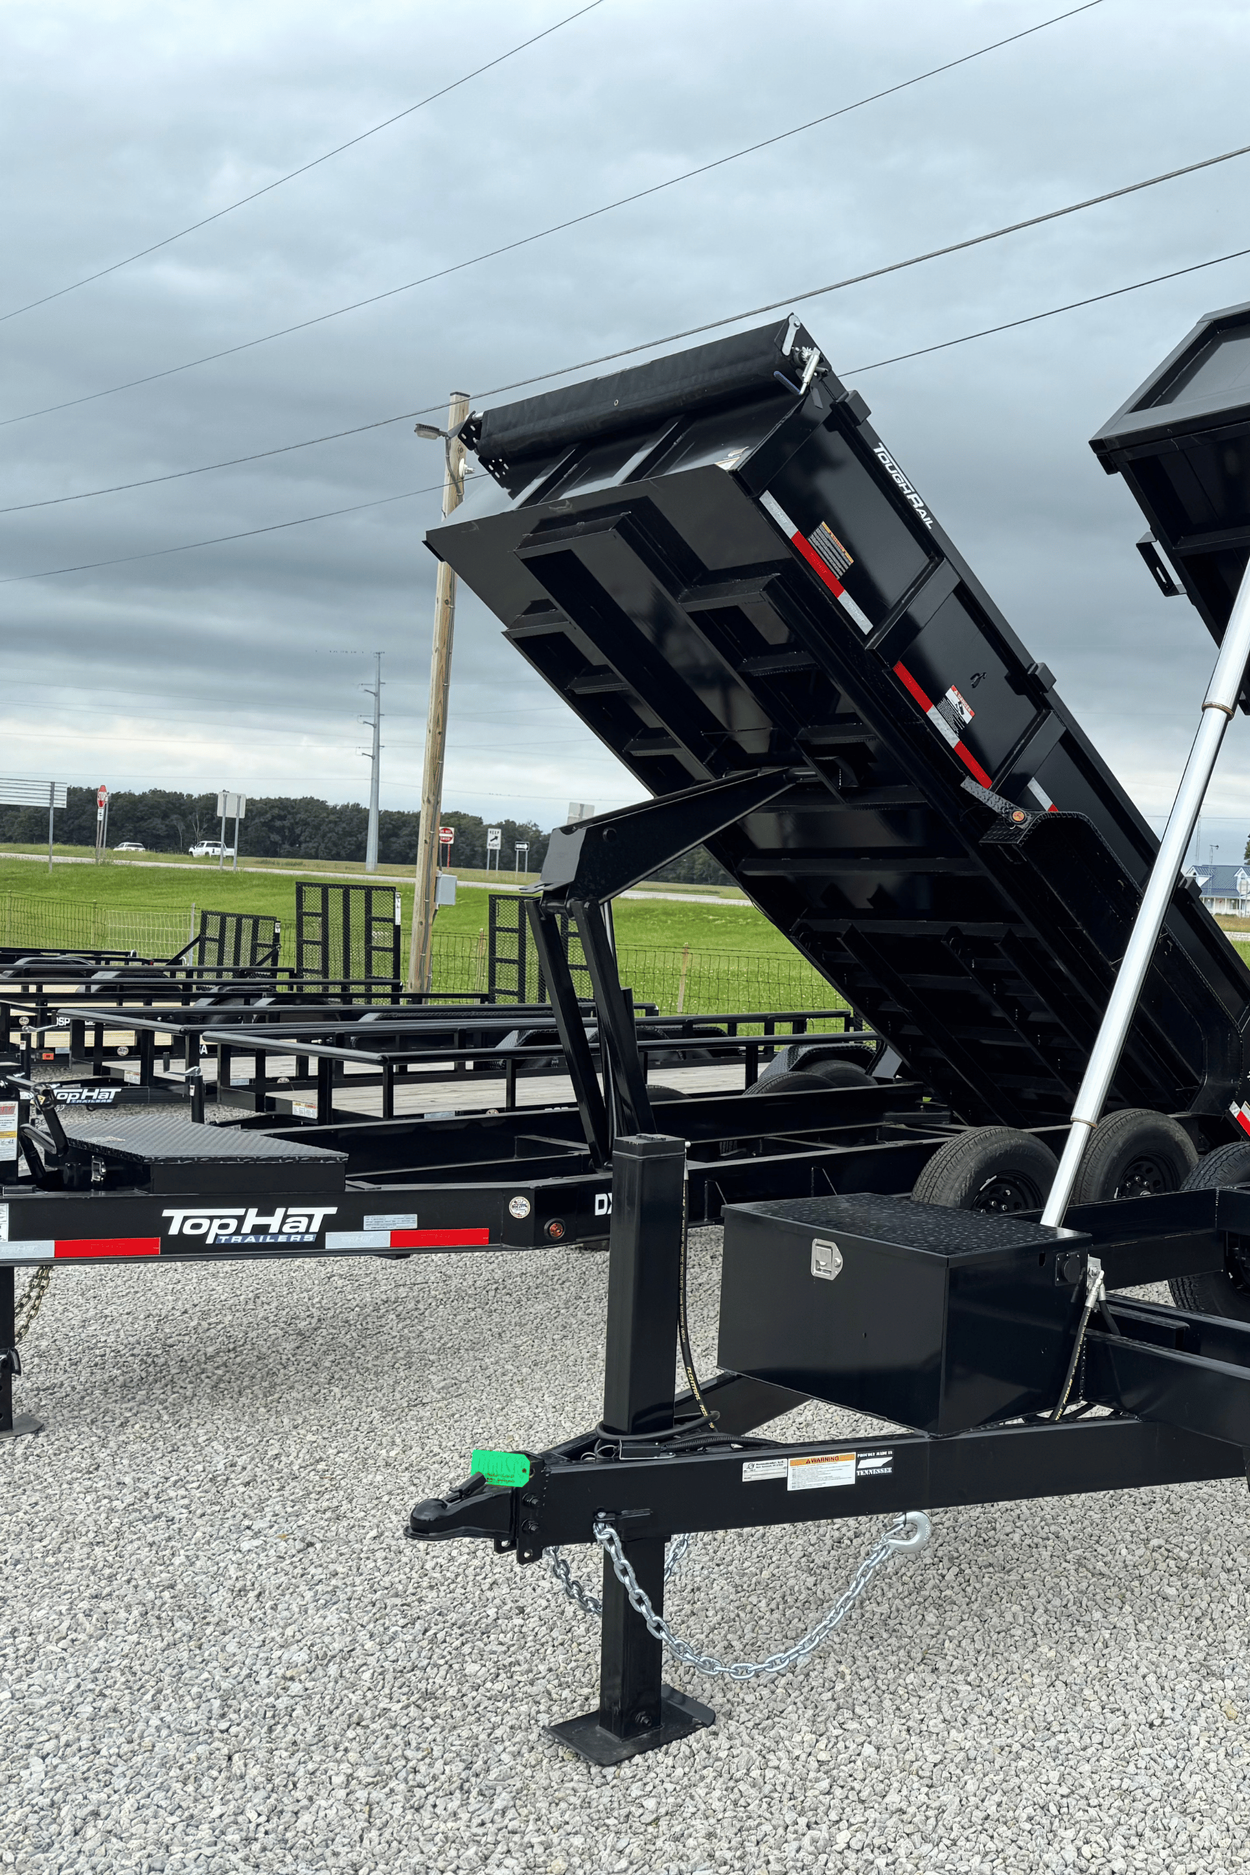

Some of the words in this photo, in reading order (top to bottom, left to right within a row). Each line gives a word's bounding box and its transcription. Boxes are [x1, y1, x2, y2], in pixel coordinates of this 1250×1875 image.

[217, 1234, 316, 1244] TRAILERS
[810, 1455, 840, 1464] WARNING
[856, 1467, 893, 1476] TENNESSEE
